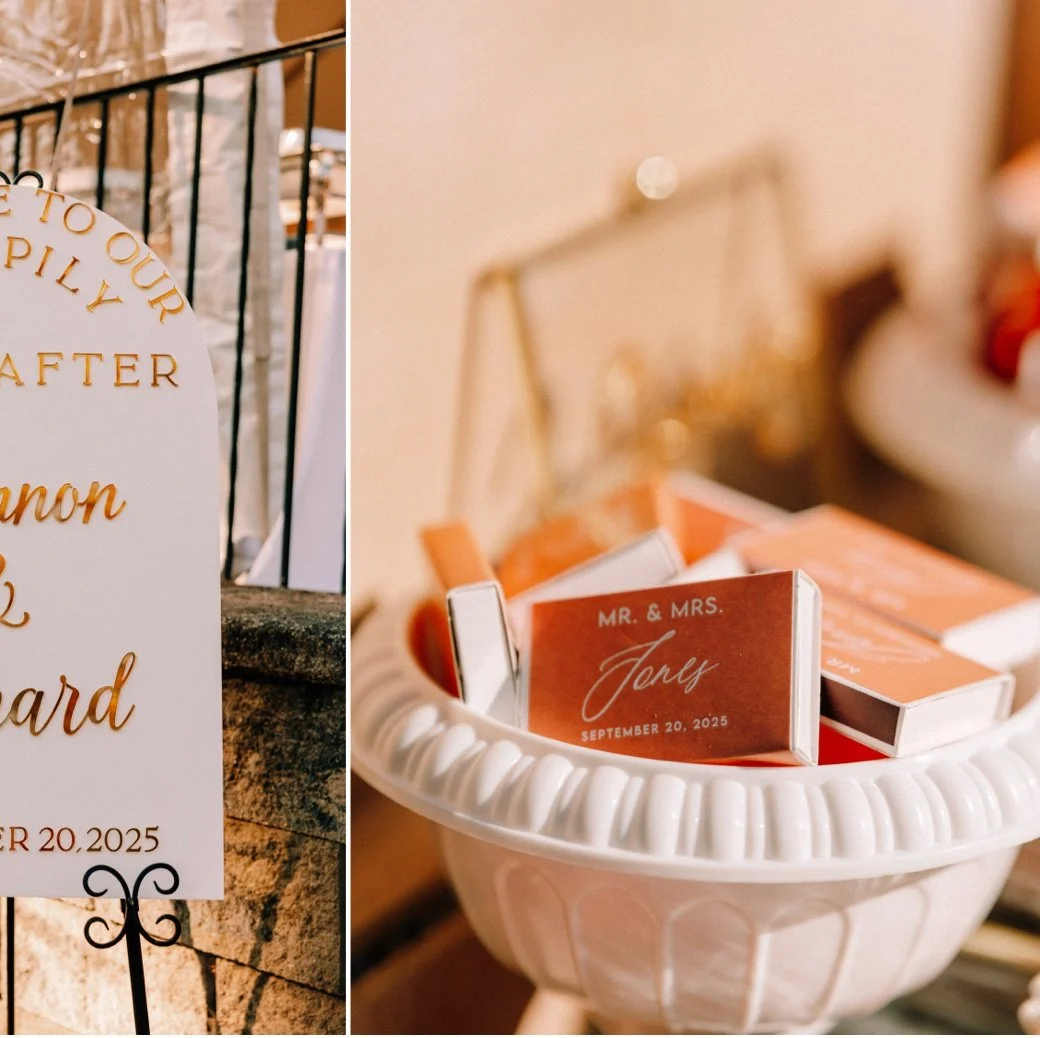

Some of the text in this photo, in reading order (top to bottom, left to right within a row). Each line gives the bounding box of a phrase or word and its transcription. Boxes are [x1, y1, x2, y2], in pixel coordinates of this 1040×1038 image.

[35, 188, 96, 234] TO
[105, 232, 186, 324] OUR
[598, 596, 724, 628] MR. & MRS.
[581, 715, 728, 742] SEPTEMBER 20, 2025
